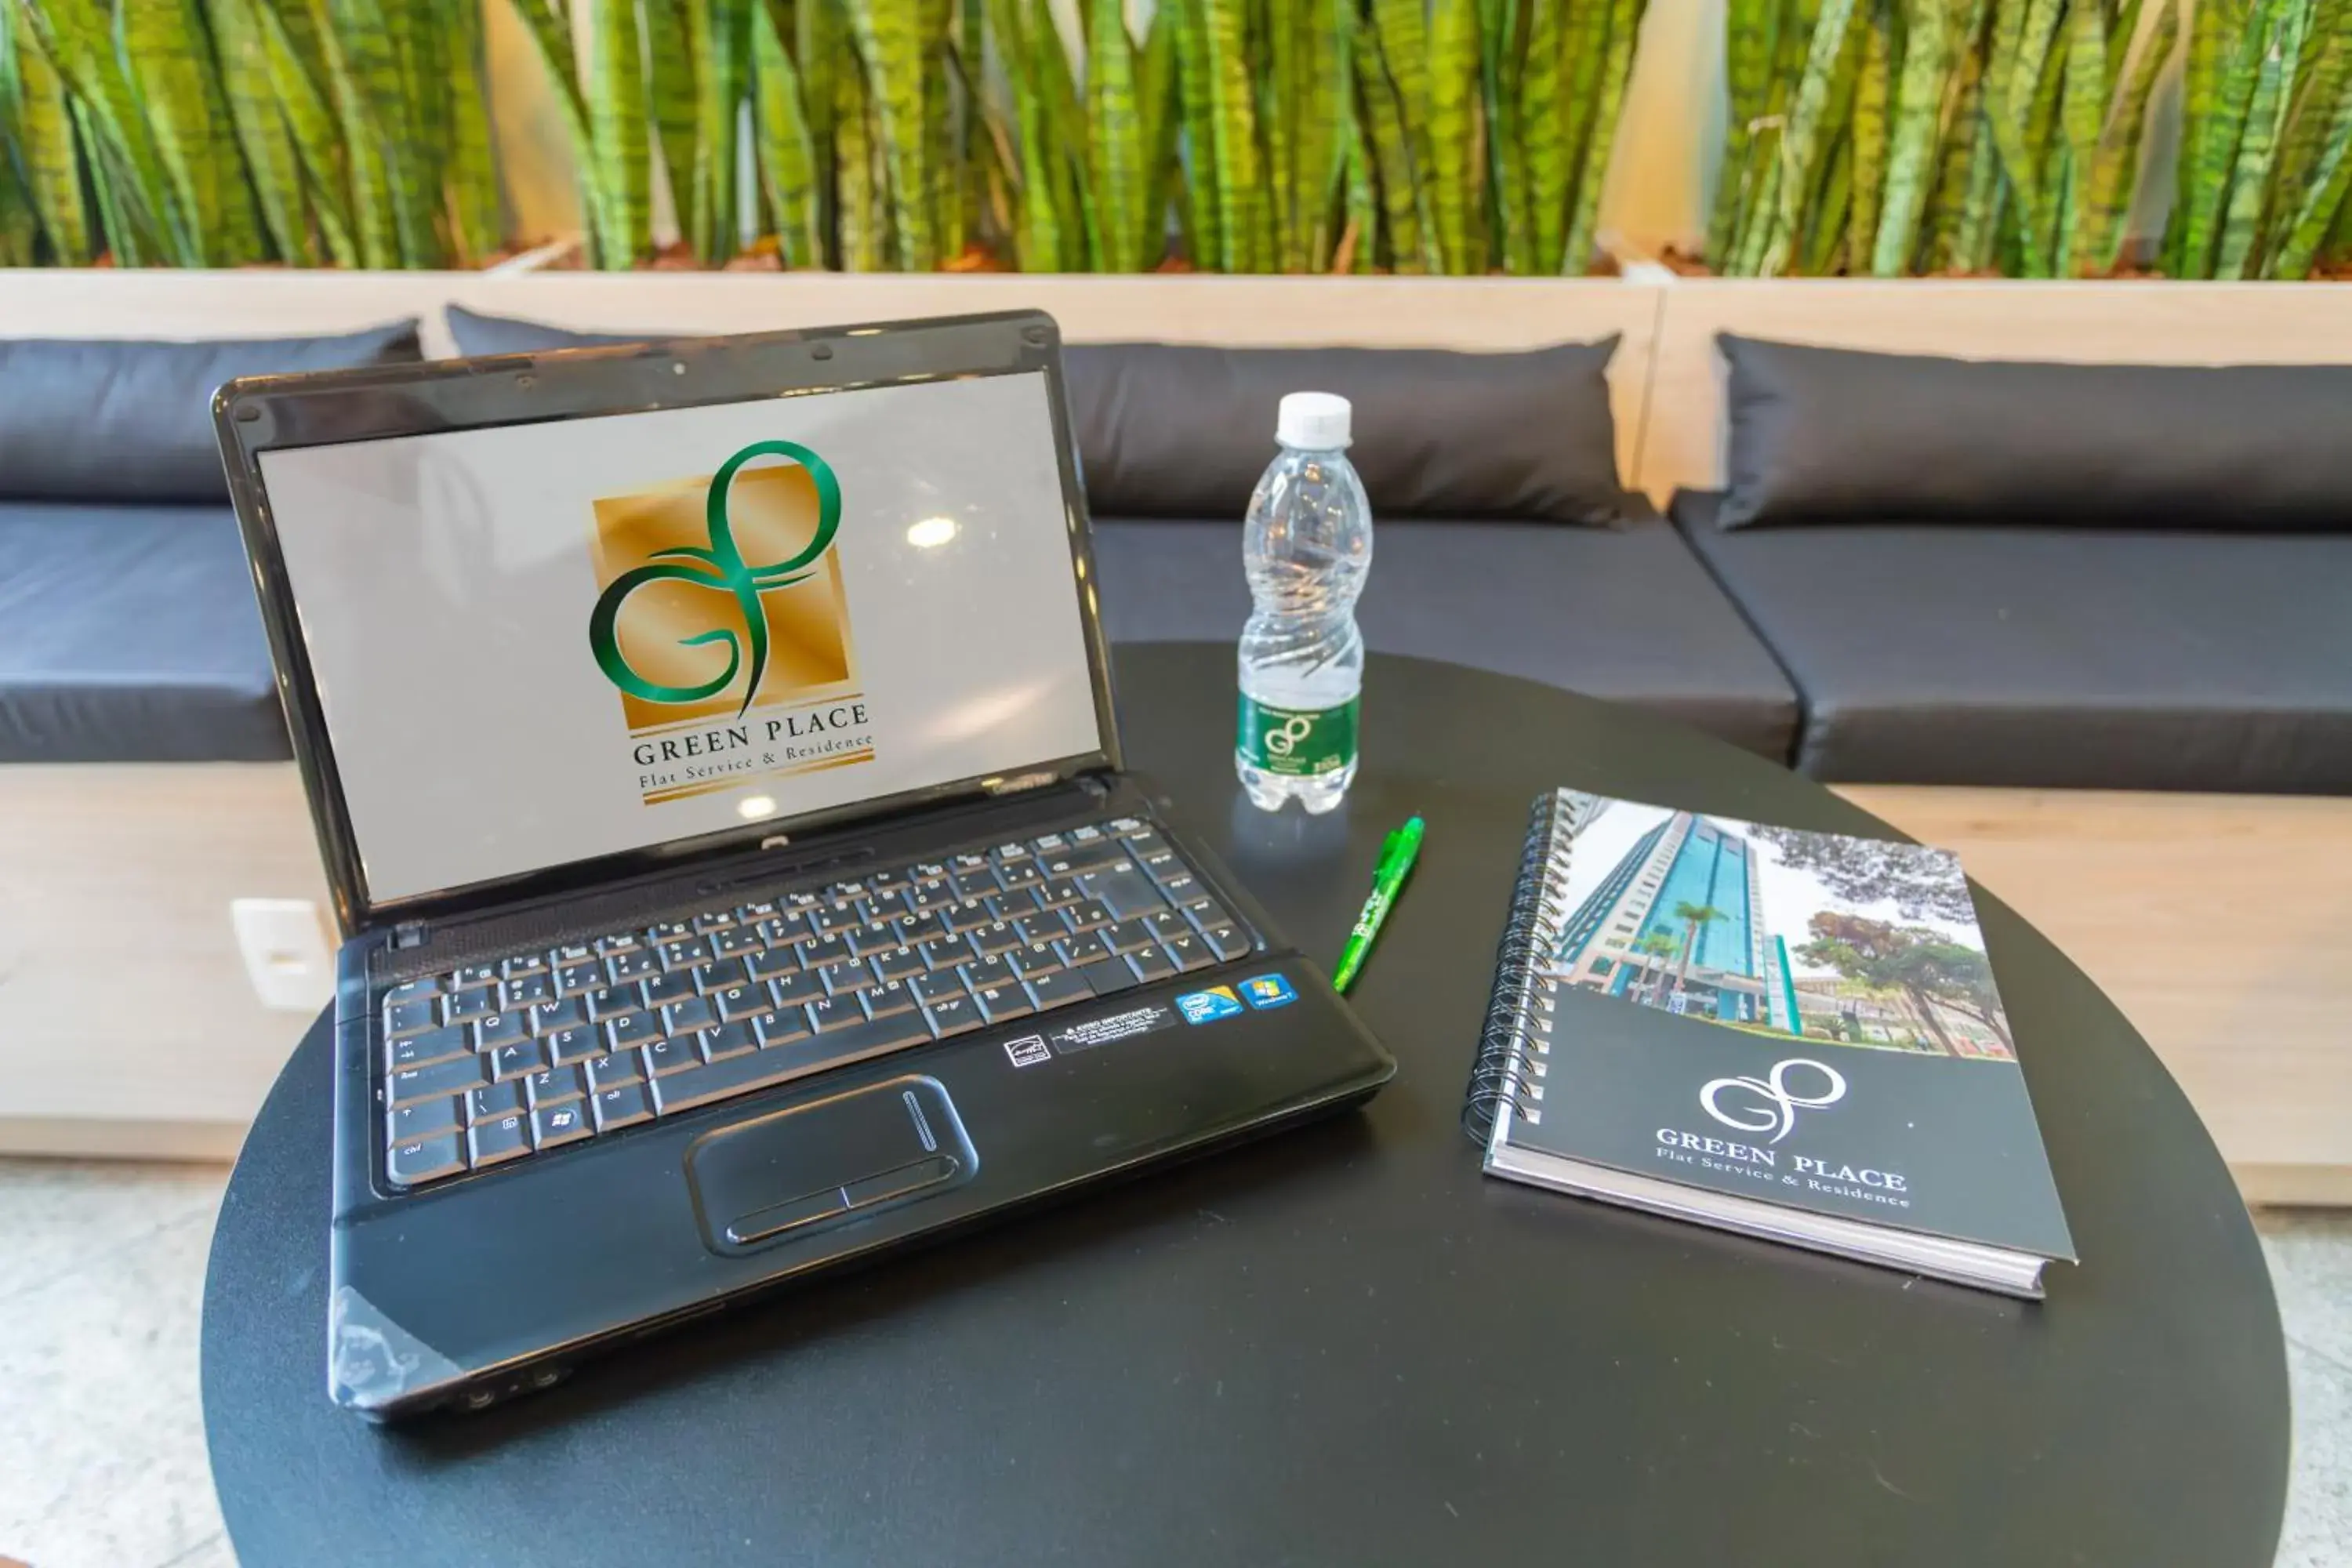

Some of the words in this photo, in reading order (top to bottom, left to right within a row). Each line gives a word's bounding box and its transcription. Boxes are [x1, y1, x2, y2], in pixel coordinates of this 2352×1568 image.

[633, 726, 750, 767] GREEN
[766, 704, 869, 742] PLACE
[639, 773, 677, 789] Flat
[686, 756, 753, 780] Service
[762, 751, 775, 764] &
[786, 733, 874, 761] Residence
[902, 915, 916, 926] O
[806, 938, 817, 949] U
[929, 940, 937, 949] L
[755, 950, 765, 960] Y
[880, 953, 891, 962] K
[703, 964, 712, 973] T
[833, 964, 839, 975] J
[652, 976, 661, 987] R
[780, 975, 792, 986] H
[598, 989, 608, 1000] E
[728, 989, 741, 1000] G
[871, 986, 885, 997] M
[542, 1000, 560, 1013] W
[674, 1003, 682, 1014] F
[818, 1000, 831, 1011] N
[485, 1016, 500, 1027] Q
[619, 1017, 630, 1028] D
[765, 1014, 775, 1025] B
[563, 1031, 572, 1042] S
[710, 1026, 721, 1037] V
[504, 1047, 517, 1058] A
[655, 1041, 666, 1053] C
[598, 1057, 608, 1069] X
[539, 1072, 550, 1084] Z
[1656, 1128, 1776, 1167] GREEN
[1793, 1155, 1908, 1192] PLACE
[1656, 1147, 1694, 1165] Flat
[1700, 1156, 1774, 1181] Service
[1781, 1175, 1800, 1186] &
[1806, 1178, 1911, 1209] Residence
